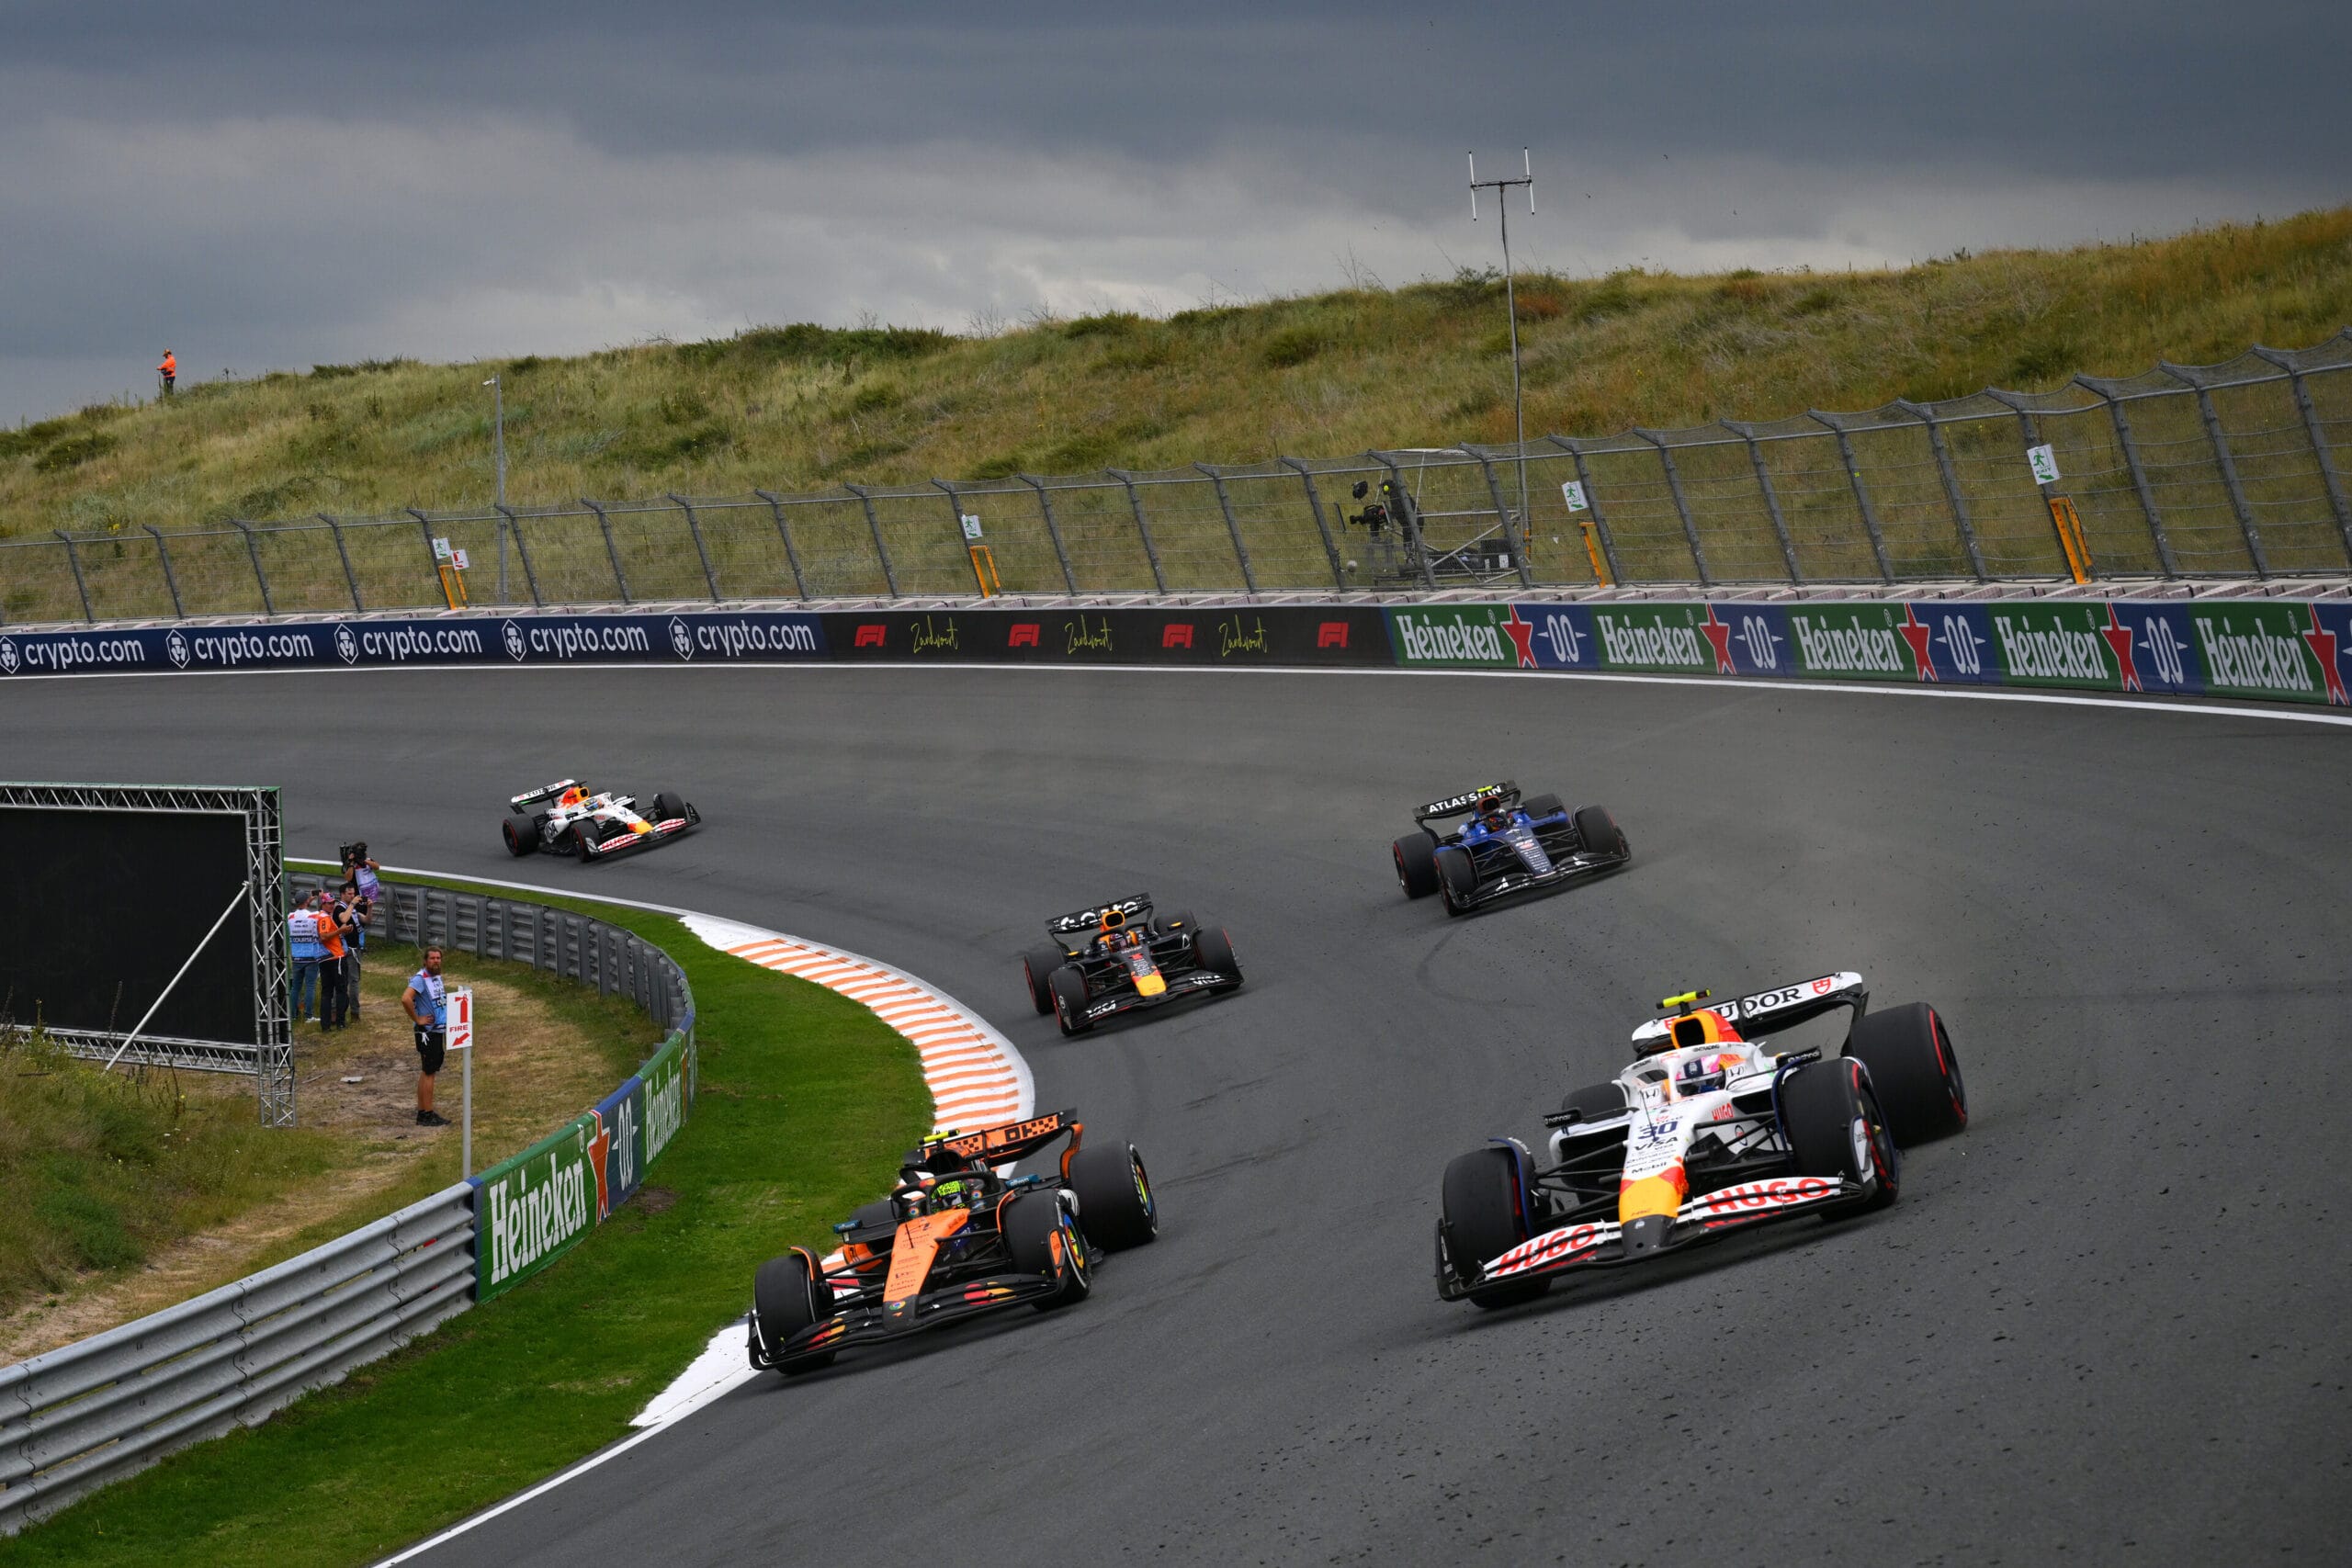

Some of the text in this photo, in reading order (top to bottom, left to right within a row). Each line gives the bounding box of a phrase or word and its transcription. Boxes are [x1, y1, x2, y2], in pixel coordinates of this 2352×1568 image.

[2036, 467, 2052, 475] EXIT
[26, 637, 144, 669] crypto.com
[196, 632, 313, 664] crypto.com
[364, 626, 482, 660] crypto.com
[531, 623, 650, 658] crypto.com
[698, 620, 816, 656] crypto.com
[1396, 615, 1504, 660] Heineken
[1598, 615, 1704, 665] Heineken
[1792, 616, 1903, 671] Heineken
[1996, 616, 2109, 679] Heineken
[2196, 617, 2313, 691] Heineken
[1716, 988, 1803, 1019] UDOR
[1712, 1102, 1735, 1121] HUGO
[1634, 1136, 1678, 1151] VISA
[1638, 1121, 1679, 1140] 30
[1704, 1178, 1830, 1213] HUGO
[490, 1153, 587, 1285] Heineken
[1497, 1224, 1595, 1275] HUGO
